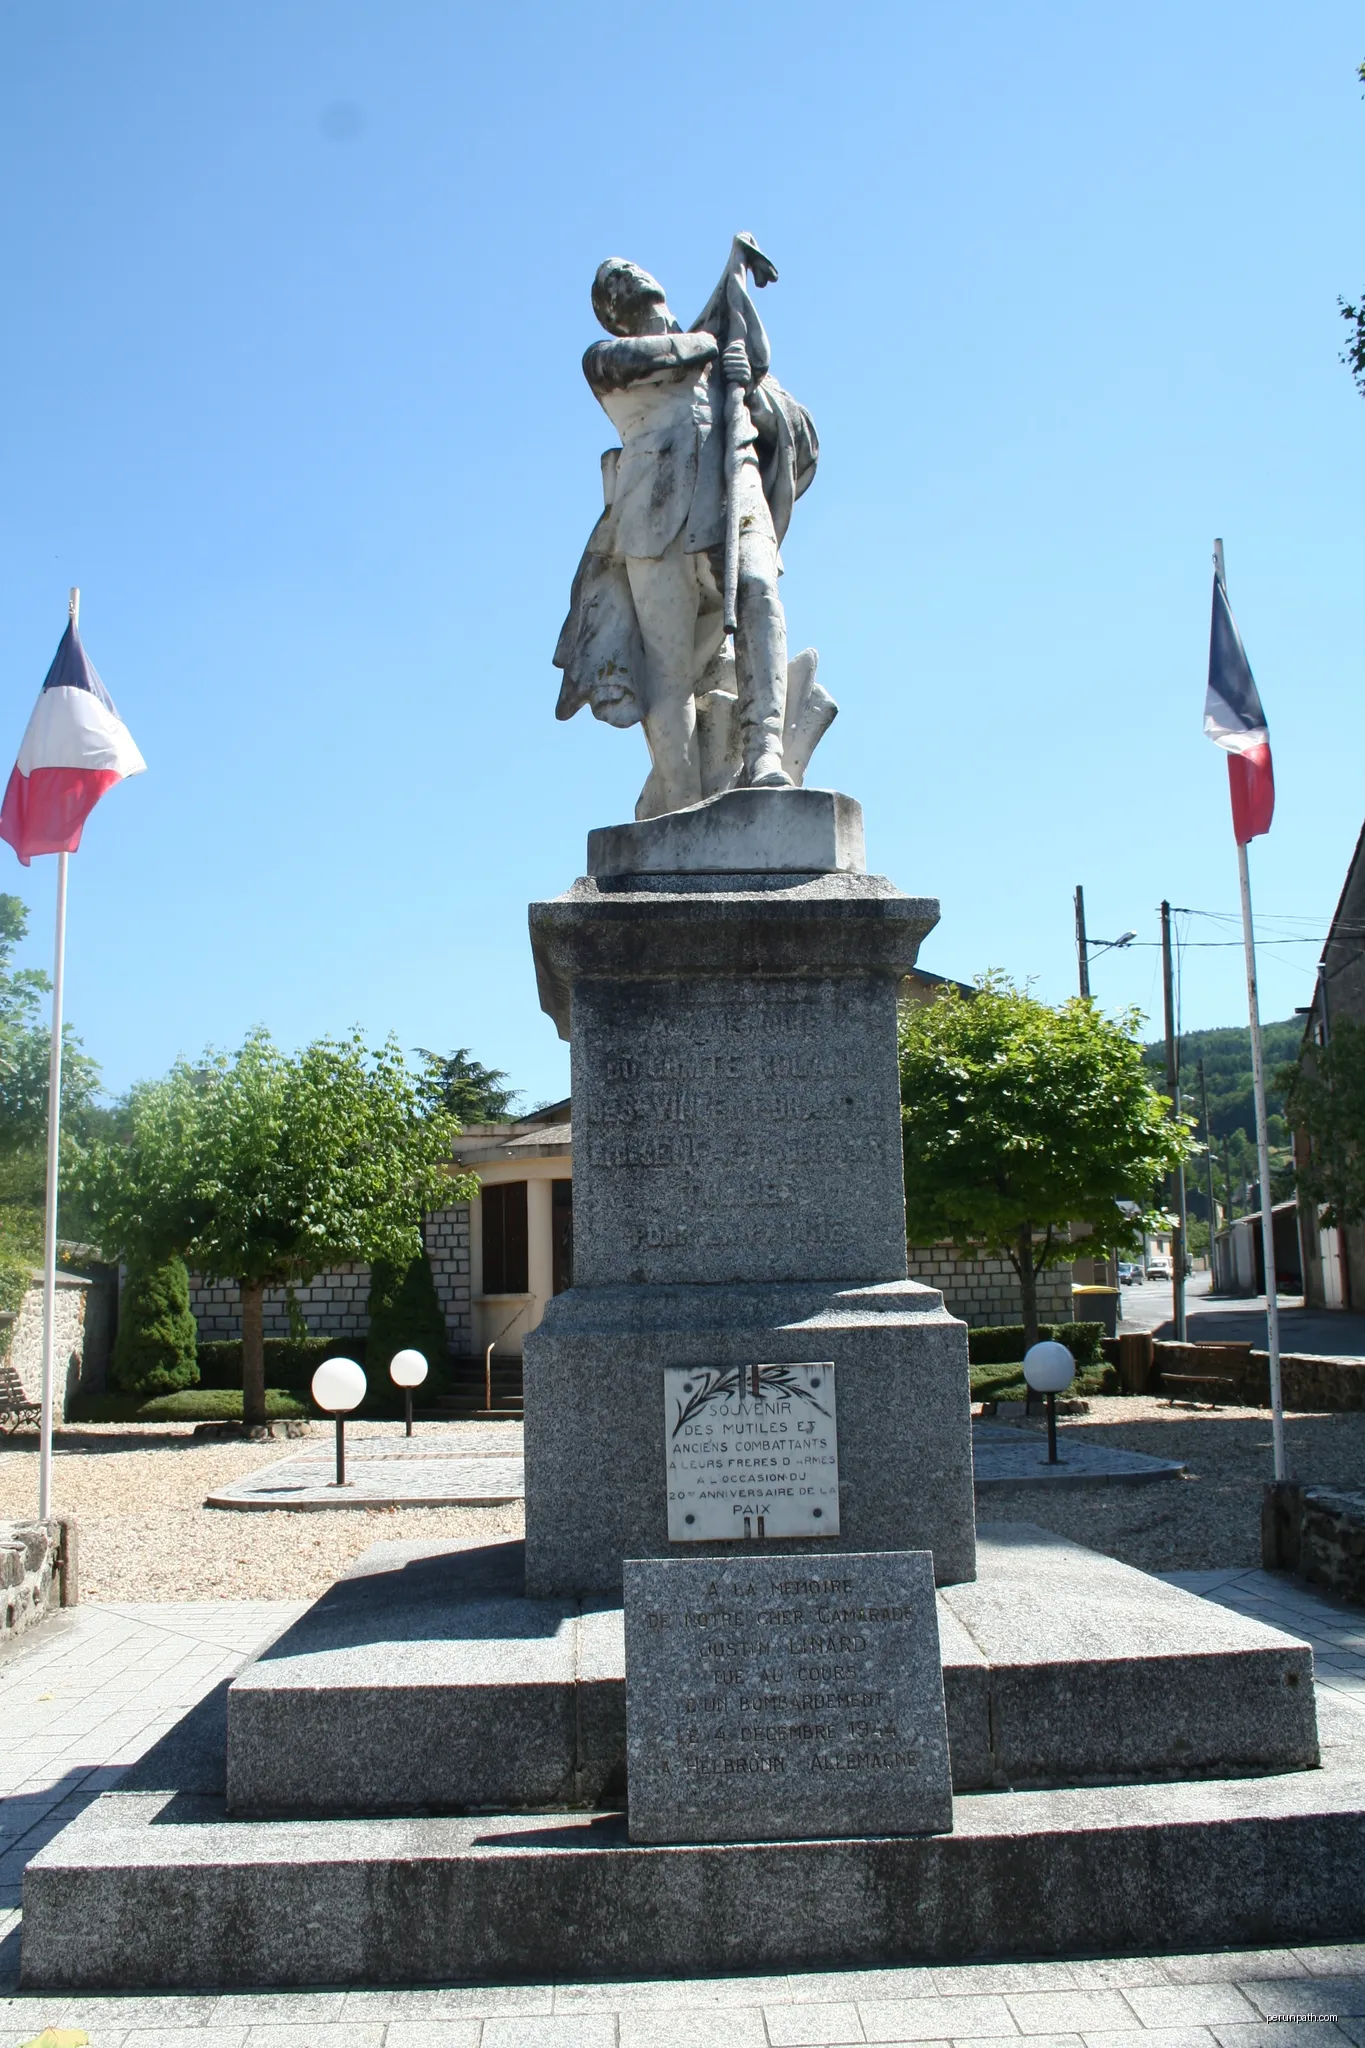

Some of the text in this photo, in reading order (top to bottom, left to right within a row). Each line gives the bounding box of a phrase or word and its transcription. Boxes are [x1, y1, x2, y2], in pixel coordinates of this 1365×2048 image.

[709, 1402, 792, 1417] SOUVENIR
[684, 1420, 817, 1436] DES MUTILES ET
[672, 1438, 828, 1455] ANCIENS COMBATTANTS
[681, 1459, 724, 1470] LEURS
[728, 1457, 778, 1468] FRERES
[789, 1471, 807, 1482] DU
[699, 1487, 795, 1500] ANNIVERSAIRE
[799, 1486, 815, 1496] DE
[819, 1486, 837, 1496] LA
[732, 1503, 771, 1516] PAIX
[684, 1611, 745, 1628] NOTRE
[757, 1609, 805, 1626] CHER
[789, 1635, 868, 1655] LINARD
[797, 1664, 857, 1682] COURS
[739, 1692, 884, 1713] BOMBARDEMENT
[713, 1725, 726, 1742] 4
